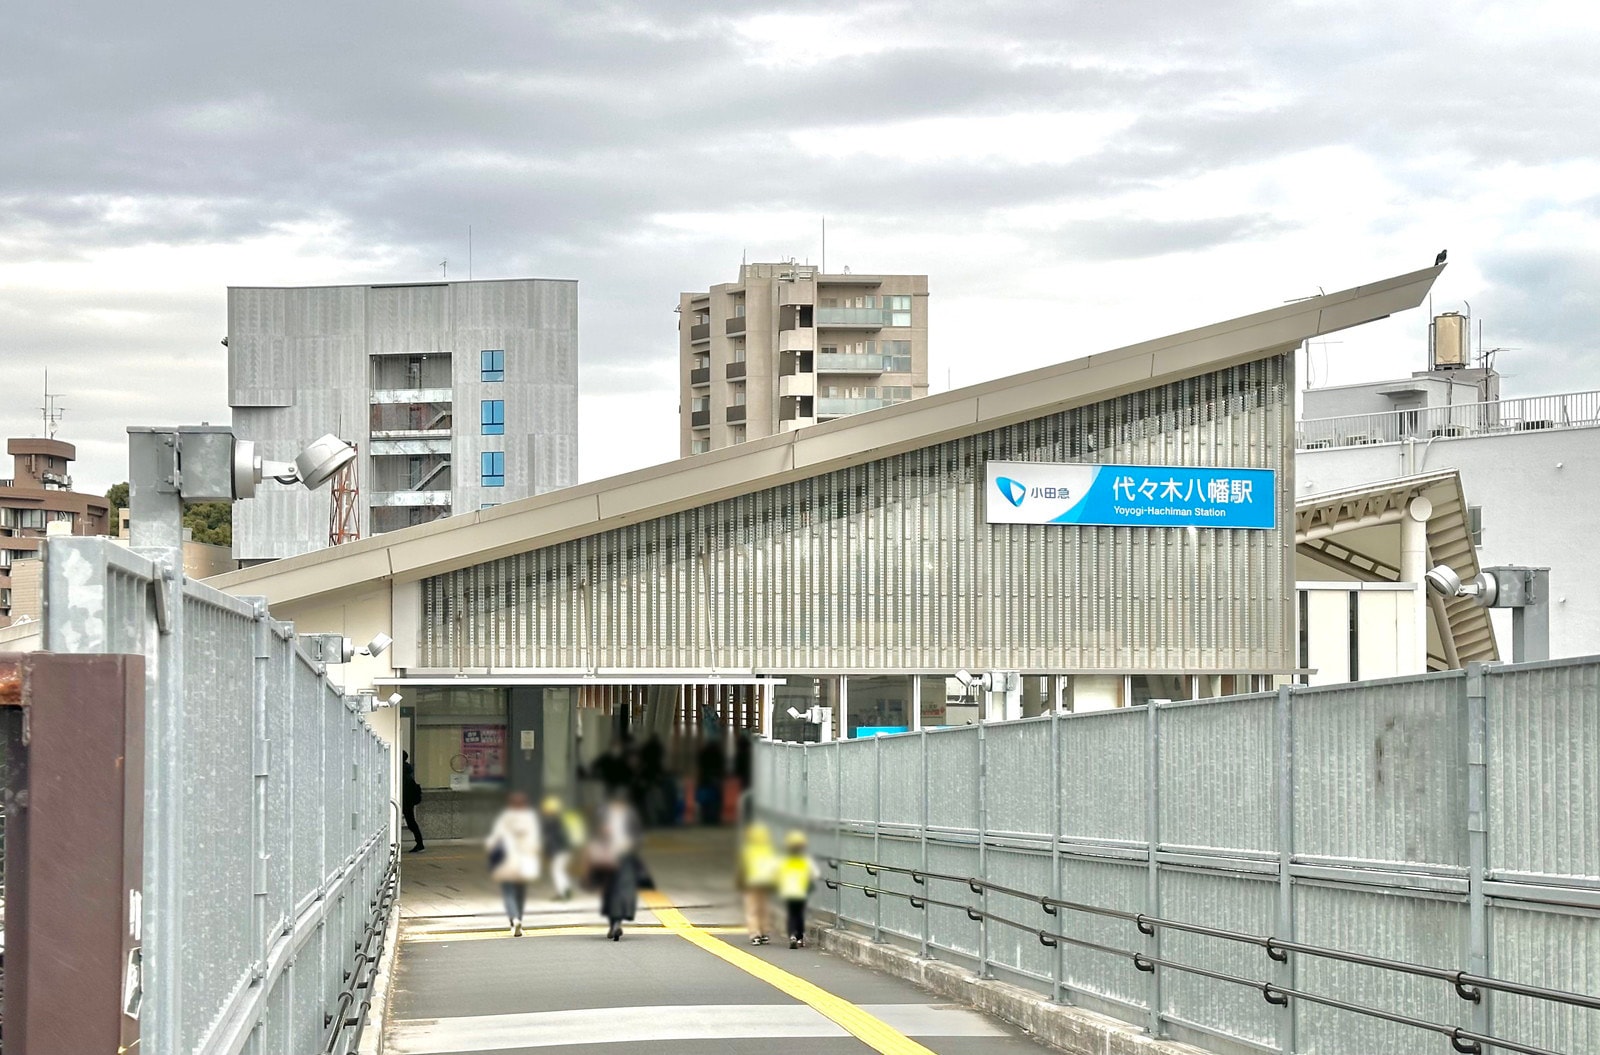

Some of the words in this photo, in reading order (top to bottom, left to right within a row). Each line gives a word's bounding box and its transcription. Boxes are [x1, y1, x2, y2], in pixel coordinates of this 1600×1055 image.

[1030, 486, 1070, 500] 小田急
[1112, 475, 1253, 504] 代々木八幡駅
[1114, 505, 1192, 517] Yoyogi-Hachiman
[1194, 507, 1227, 517] Station
